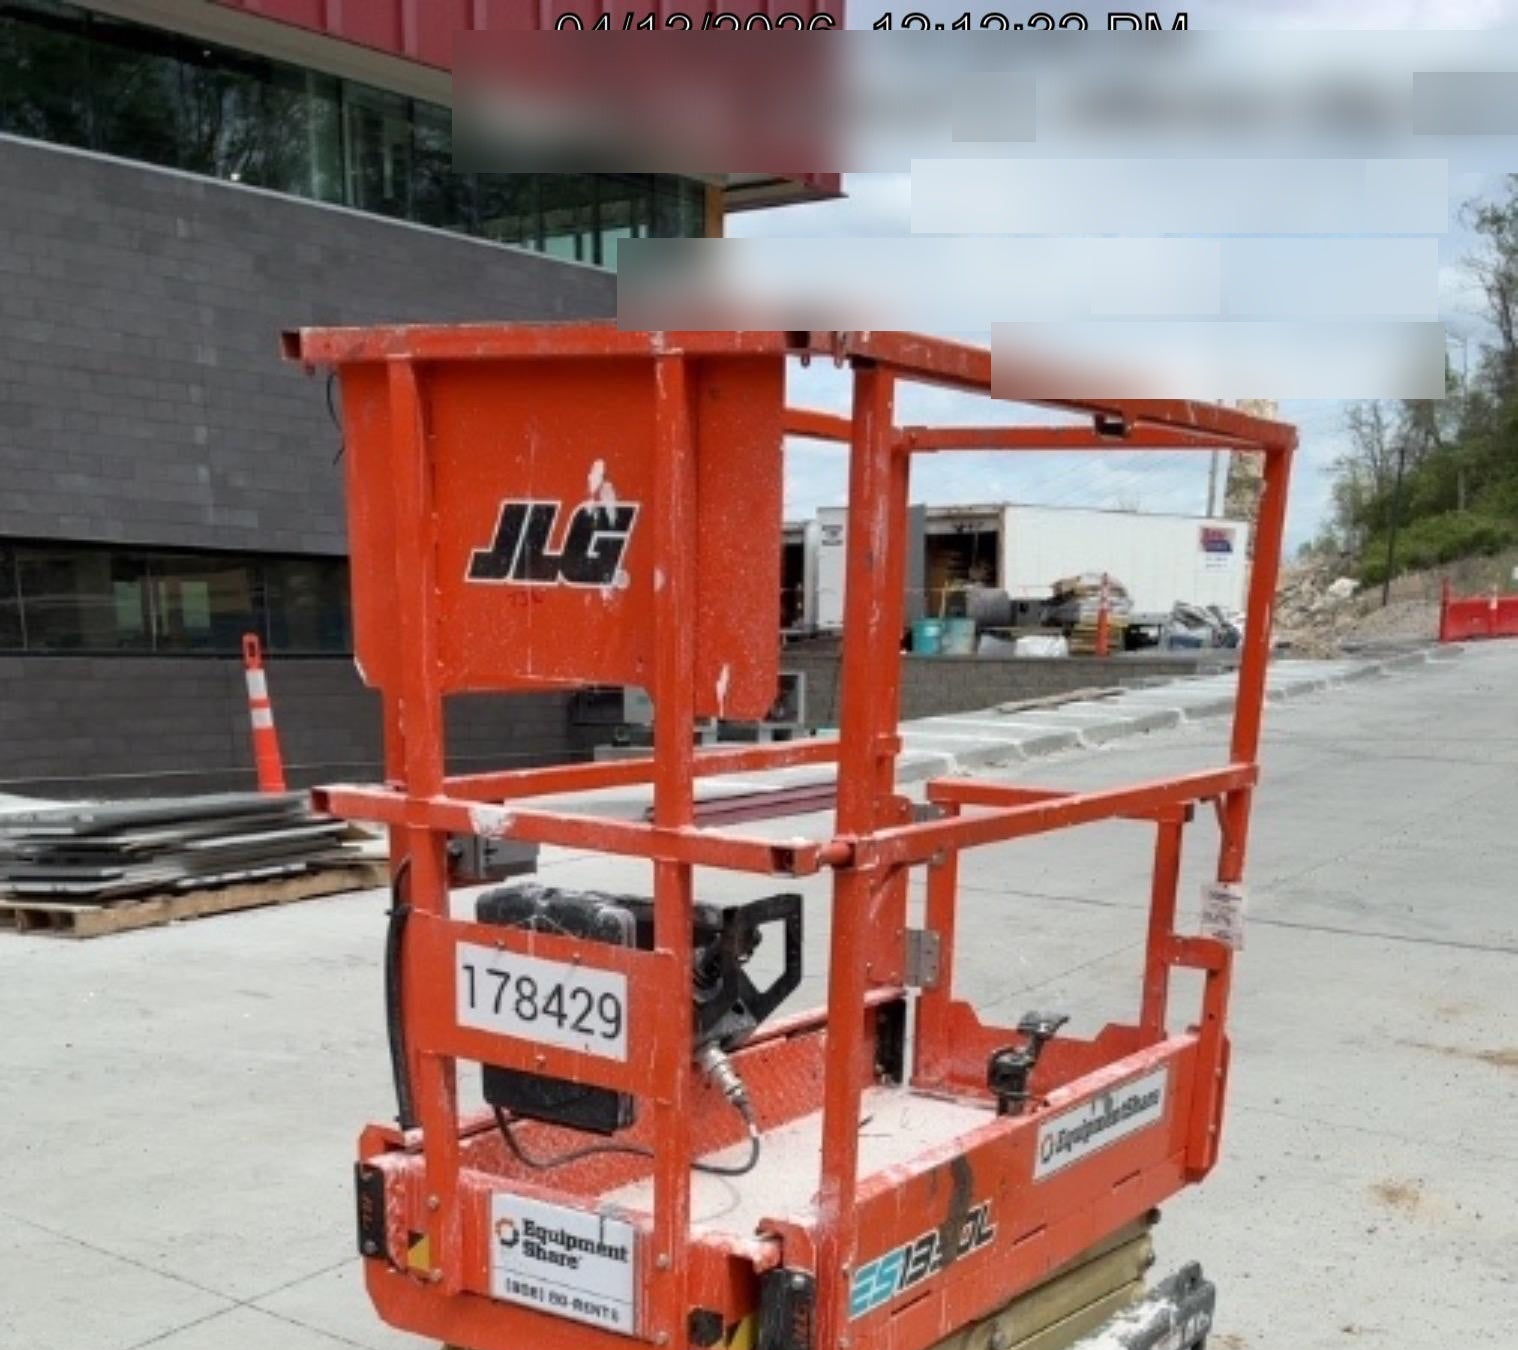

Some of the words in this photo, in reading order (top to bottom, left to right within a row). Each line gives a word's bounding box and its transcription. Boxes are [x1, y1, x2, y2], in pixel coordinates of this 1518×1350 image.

[464, 498, 641, 589] JLG
[462, 965, 622, 1039] 178429
[522, 1217, 628, 1263] Equipment
[522, 1239, 580, 1270] Share
